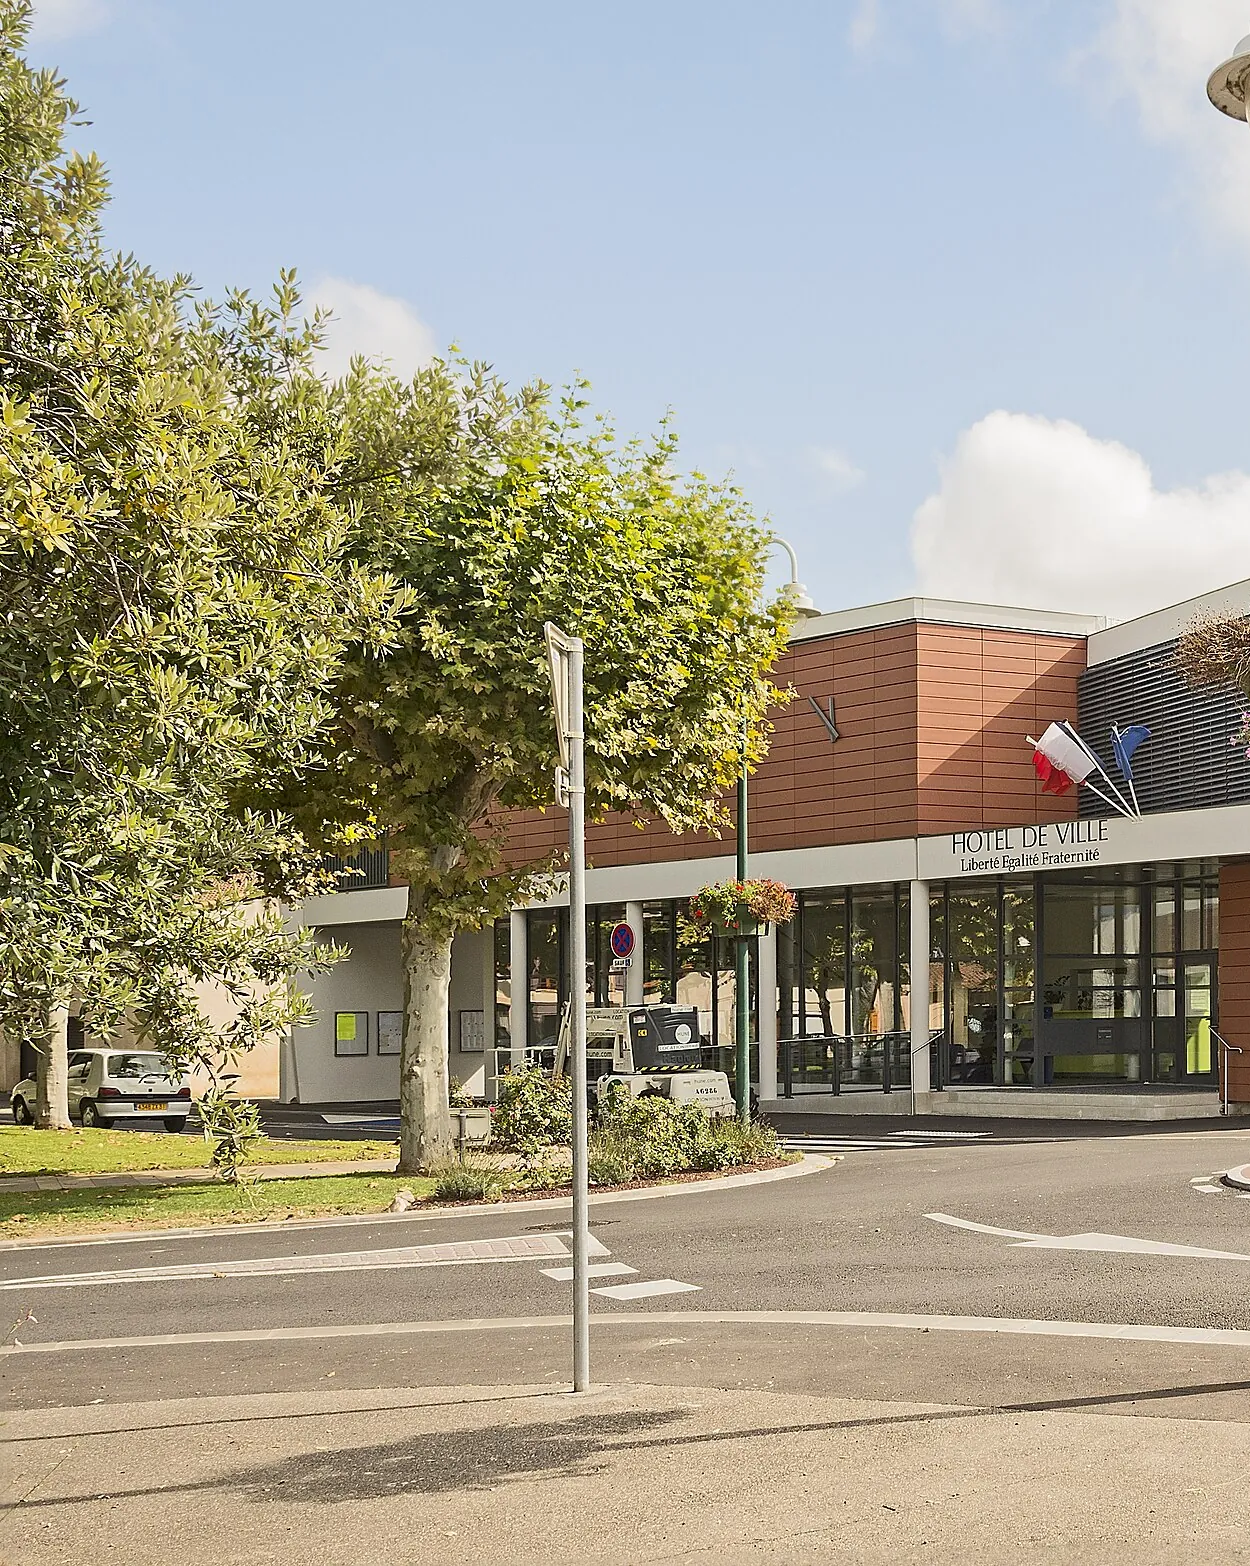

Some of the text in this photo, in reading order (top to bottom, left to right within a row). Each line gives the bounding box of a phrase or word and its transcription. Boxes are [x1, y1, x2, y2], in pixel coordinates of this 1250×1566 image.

[952, 819, 1109, 855] HOTEL DE VILLE
[960, 847, 1100, 872] Liberté Egalité Fraternité
